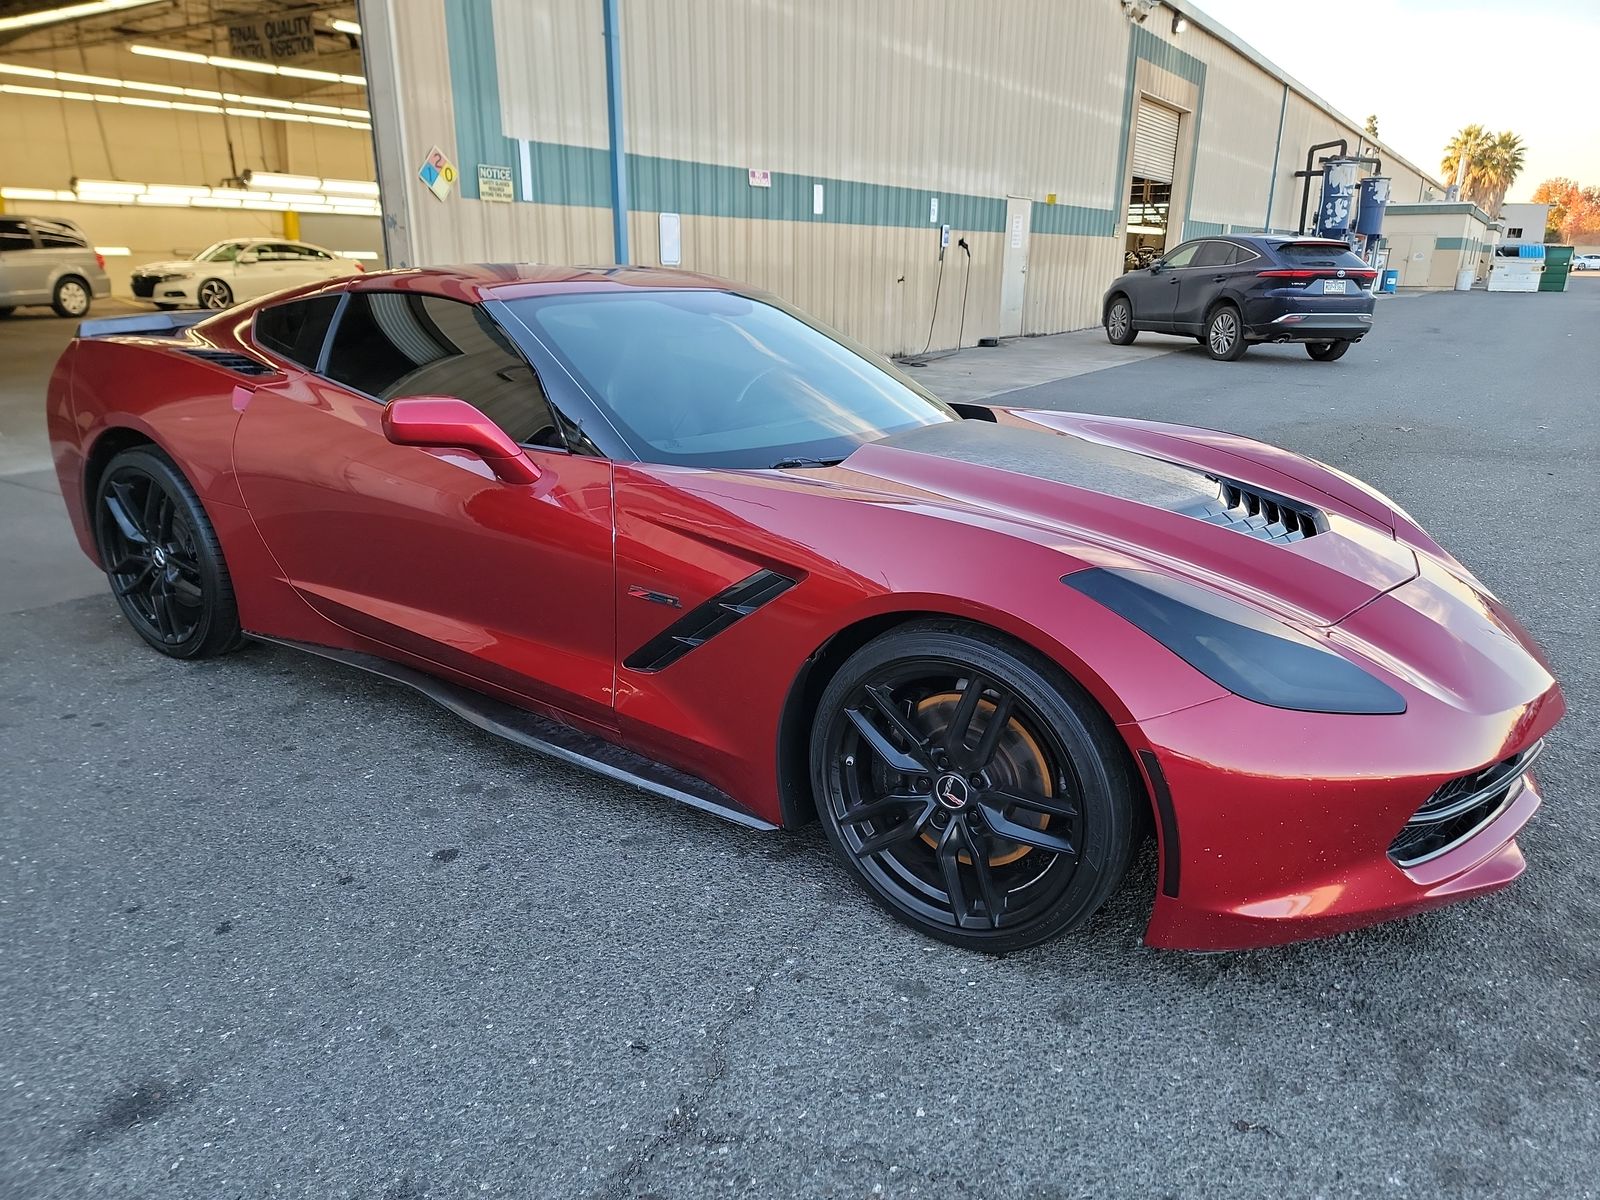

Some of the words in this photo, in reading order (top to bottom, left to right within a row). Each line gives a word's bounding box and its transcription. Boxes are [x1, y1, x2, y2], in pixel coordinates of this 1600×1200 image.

[229, 25, 260, 42] FINAL
[264, 15, 312, 39] QUALITY
[434, 153, 442, 169] 2
[444, 167, 453, 182] 0
[480, 167, 511, 180] NOTICE
